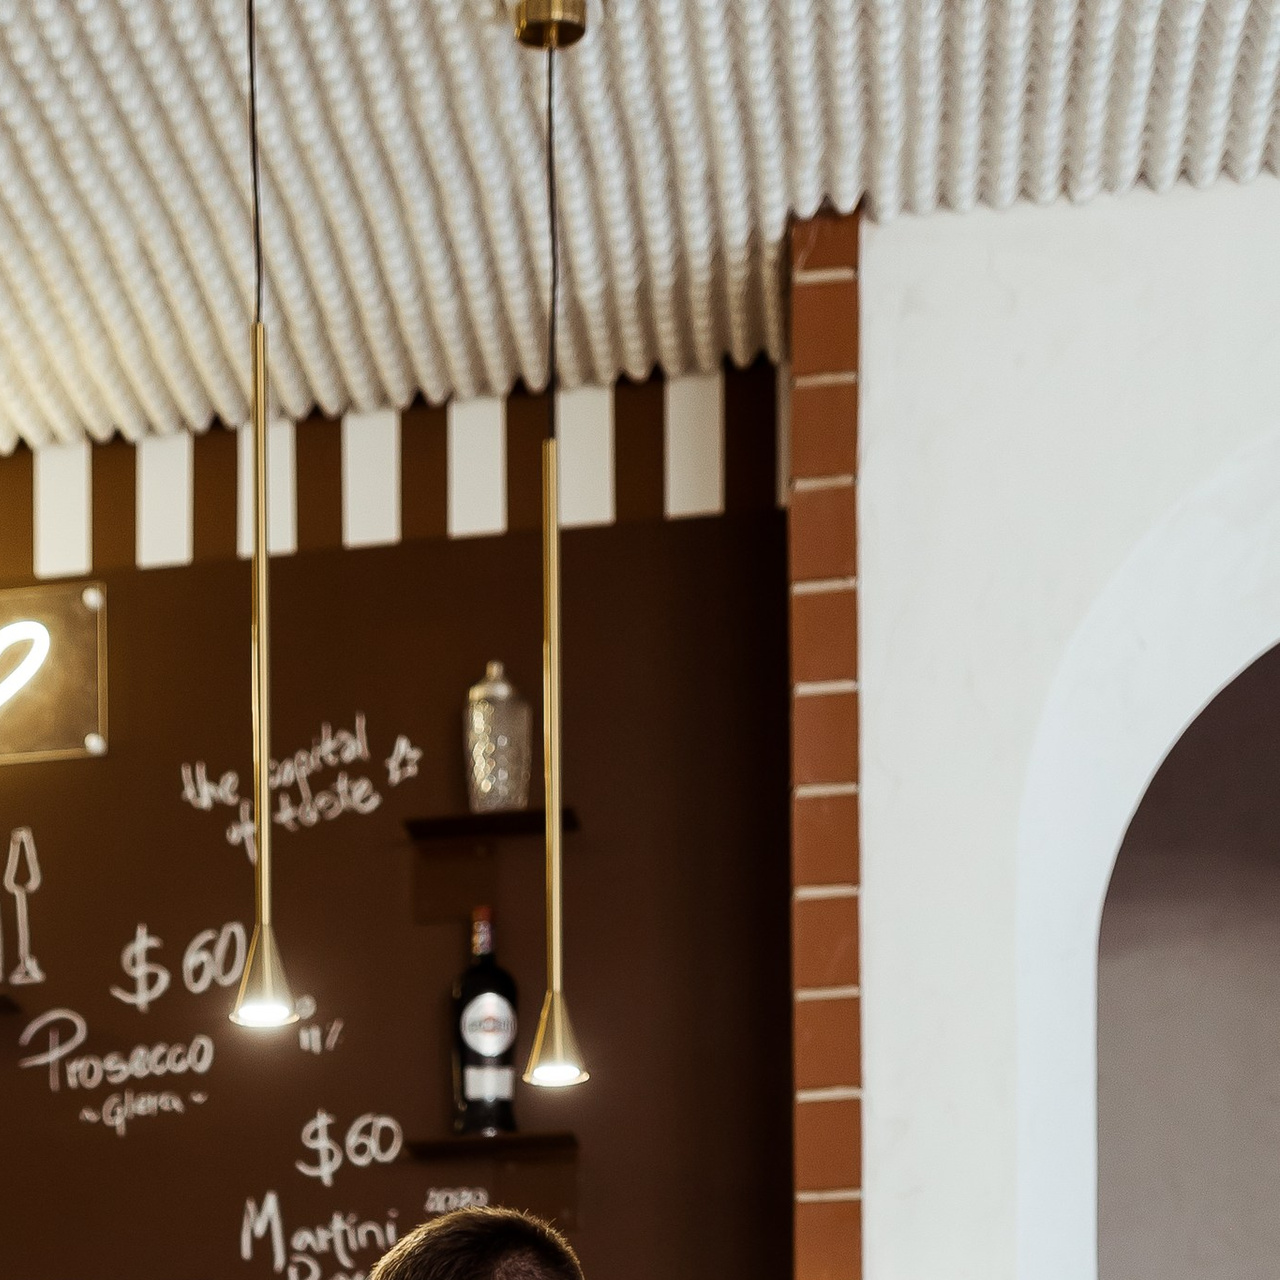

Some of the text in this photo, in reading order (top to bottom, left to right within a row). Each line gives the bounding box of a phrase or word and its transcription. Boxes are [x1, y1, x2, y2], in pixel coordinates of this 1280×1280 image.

[180, 760, 240, 811] the
[19, 1008, 215, 1093] Prosecco
[294, 1108, 403, 1187] $60
[239, 1189, 399, 1273] Martini
